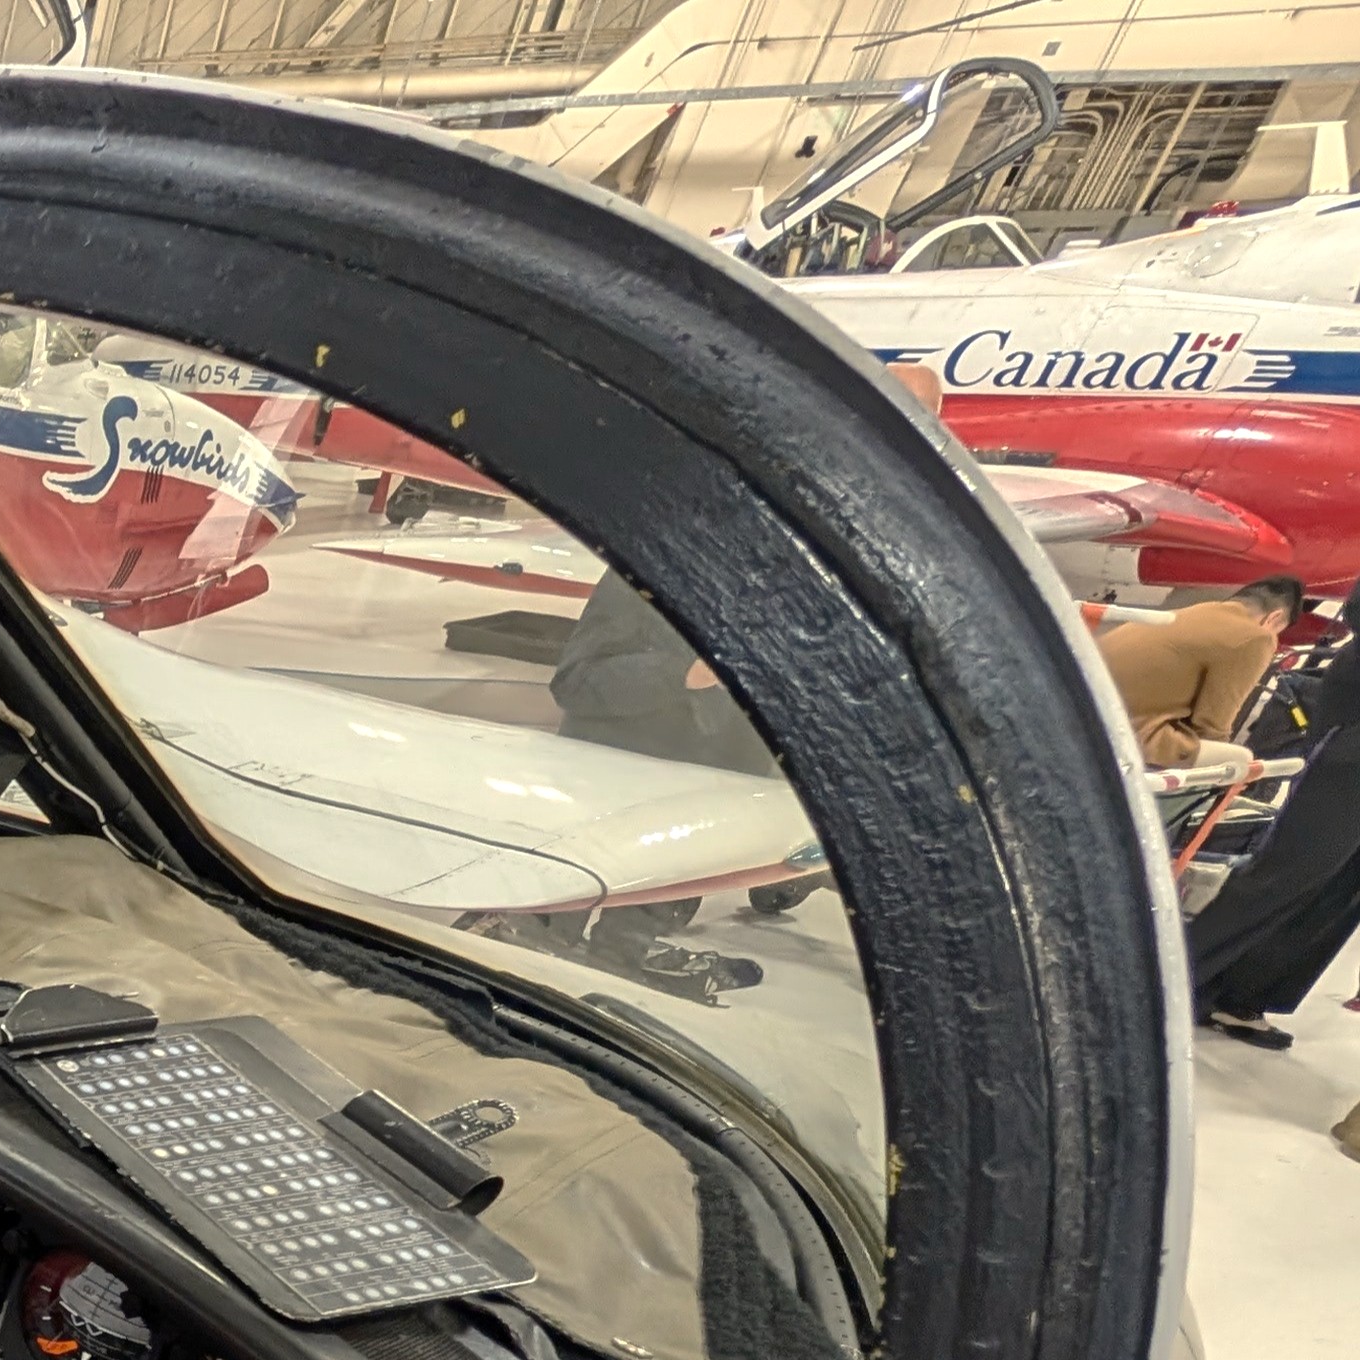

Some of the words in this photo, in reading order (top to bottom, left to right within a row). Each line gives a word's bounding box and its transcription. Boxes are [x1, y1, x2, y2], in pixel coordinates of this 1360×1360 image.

[169, 363, 243, 386] 114054
[944, 329, 1219, 391] Canada
[42, 396, 251, 503] Snowbirds
